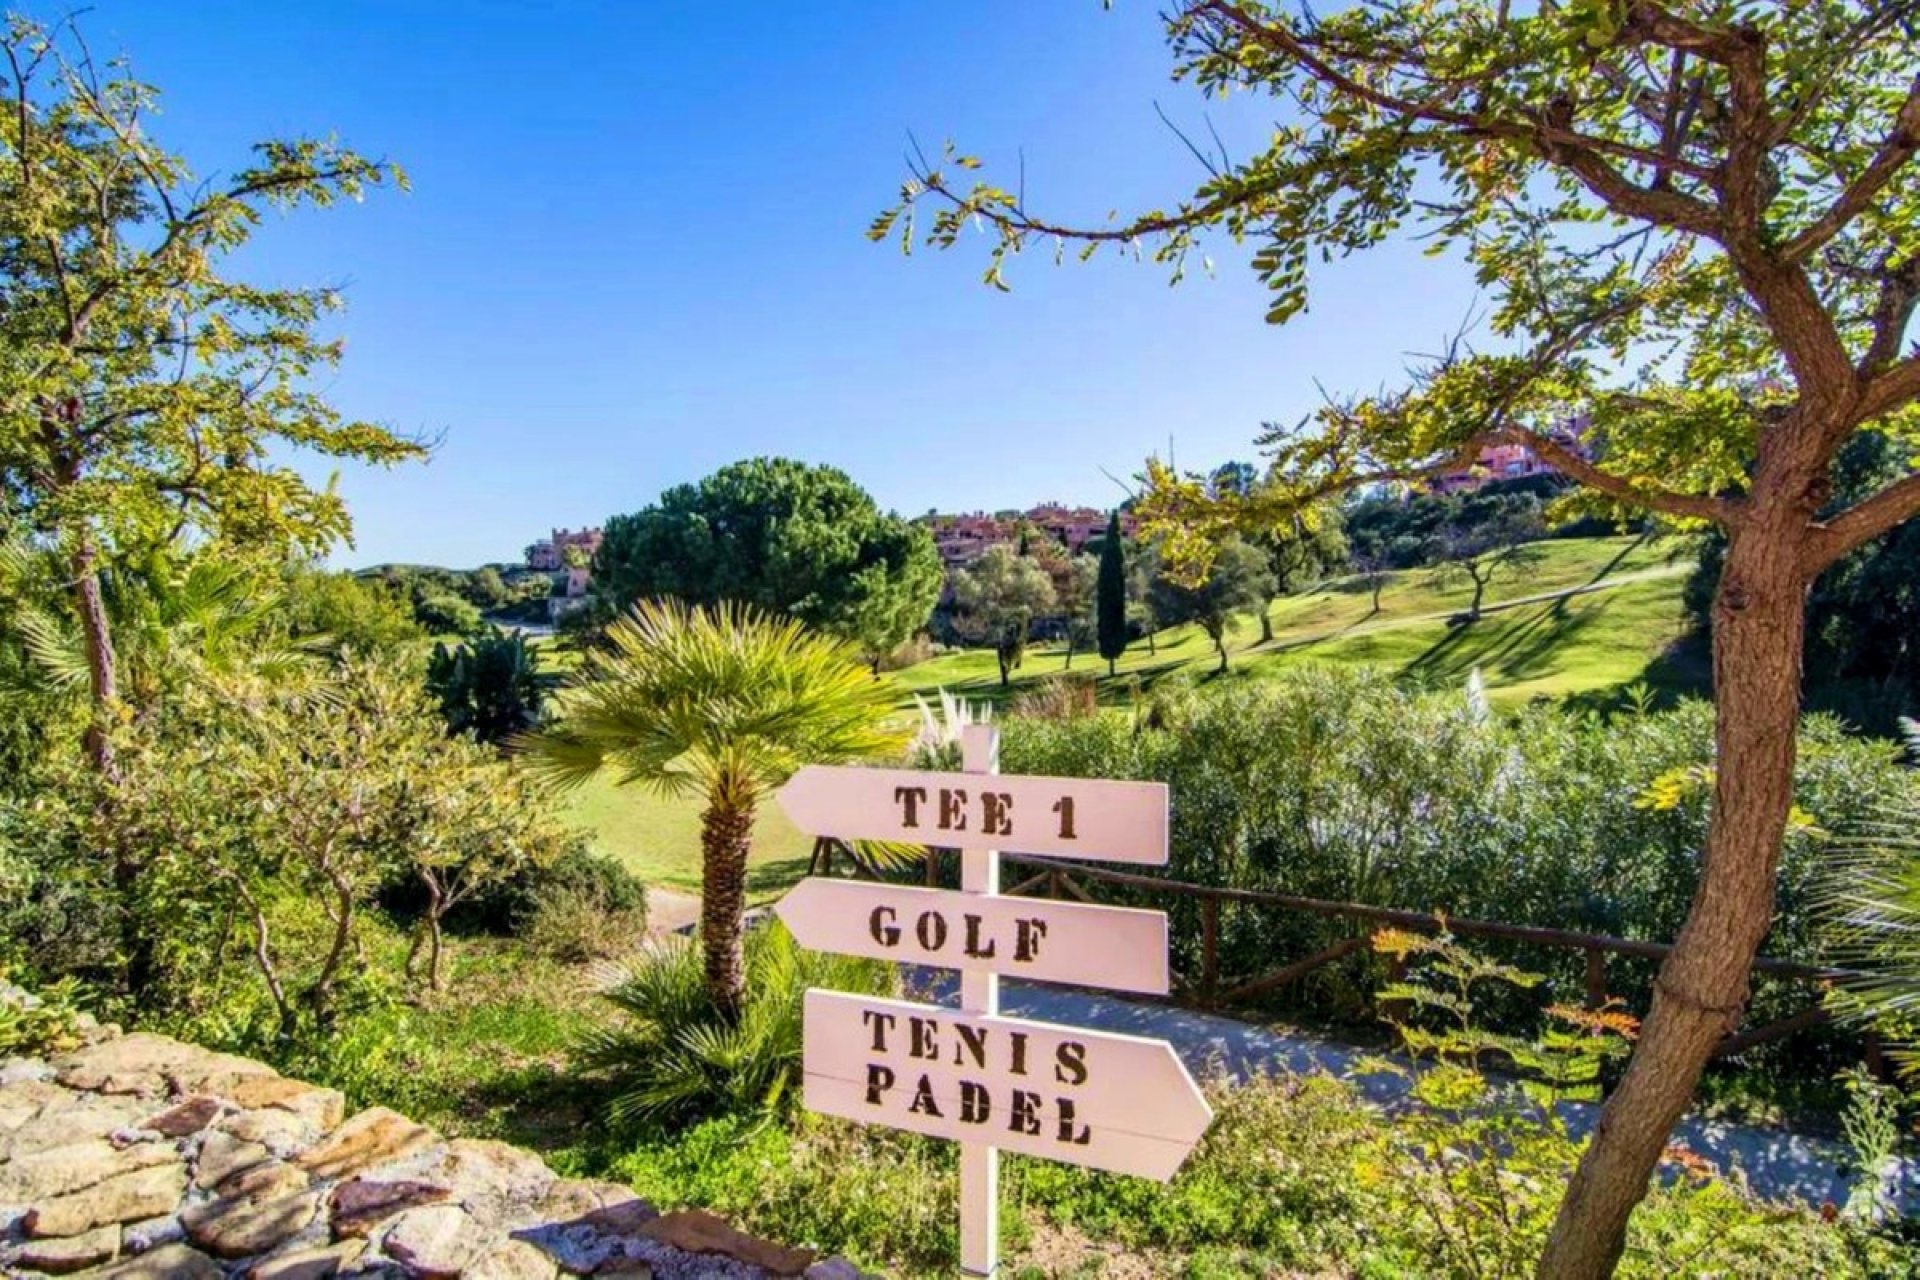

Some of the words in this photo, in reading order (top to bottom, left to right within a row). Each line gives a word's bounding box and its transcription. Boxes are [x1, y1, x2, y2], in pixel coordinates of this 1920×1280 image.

[895, 786, 1013, 836] TEE
[1052, 796, 1078, 840] 1
[868, 905, 1048, 962] GOLF
[863, 1010, 1088, 1086] TENIS
[865, 1063, 1091, 1145] PADEL
